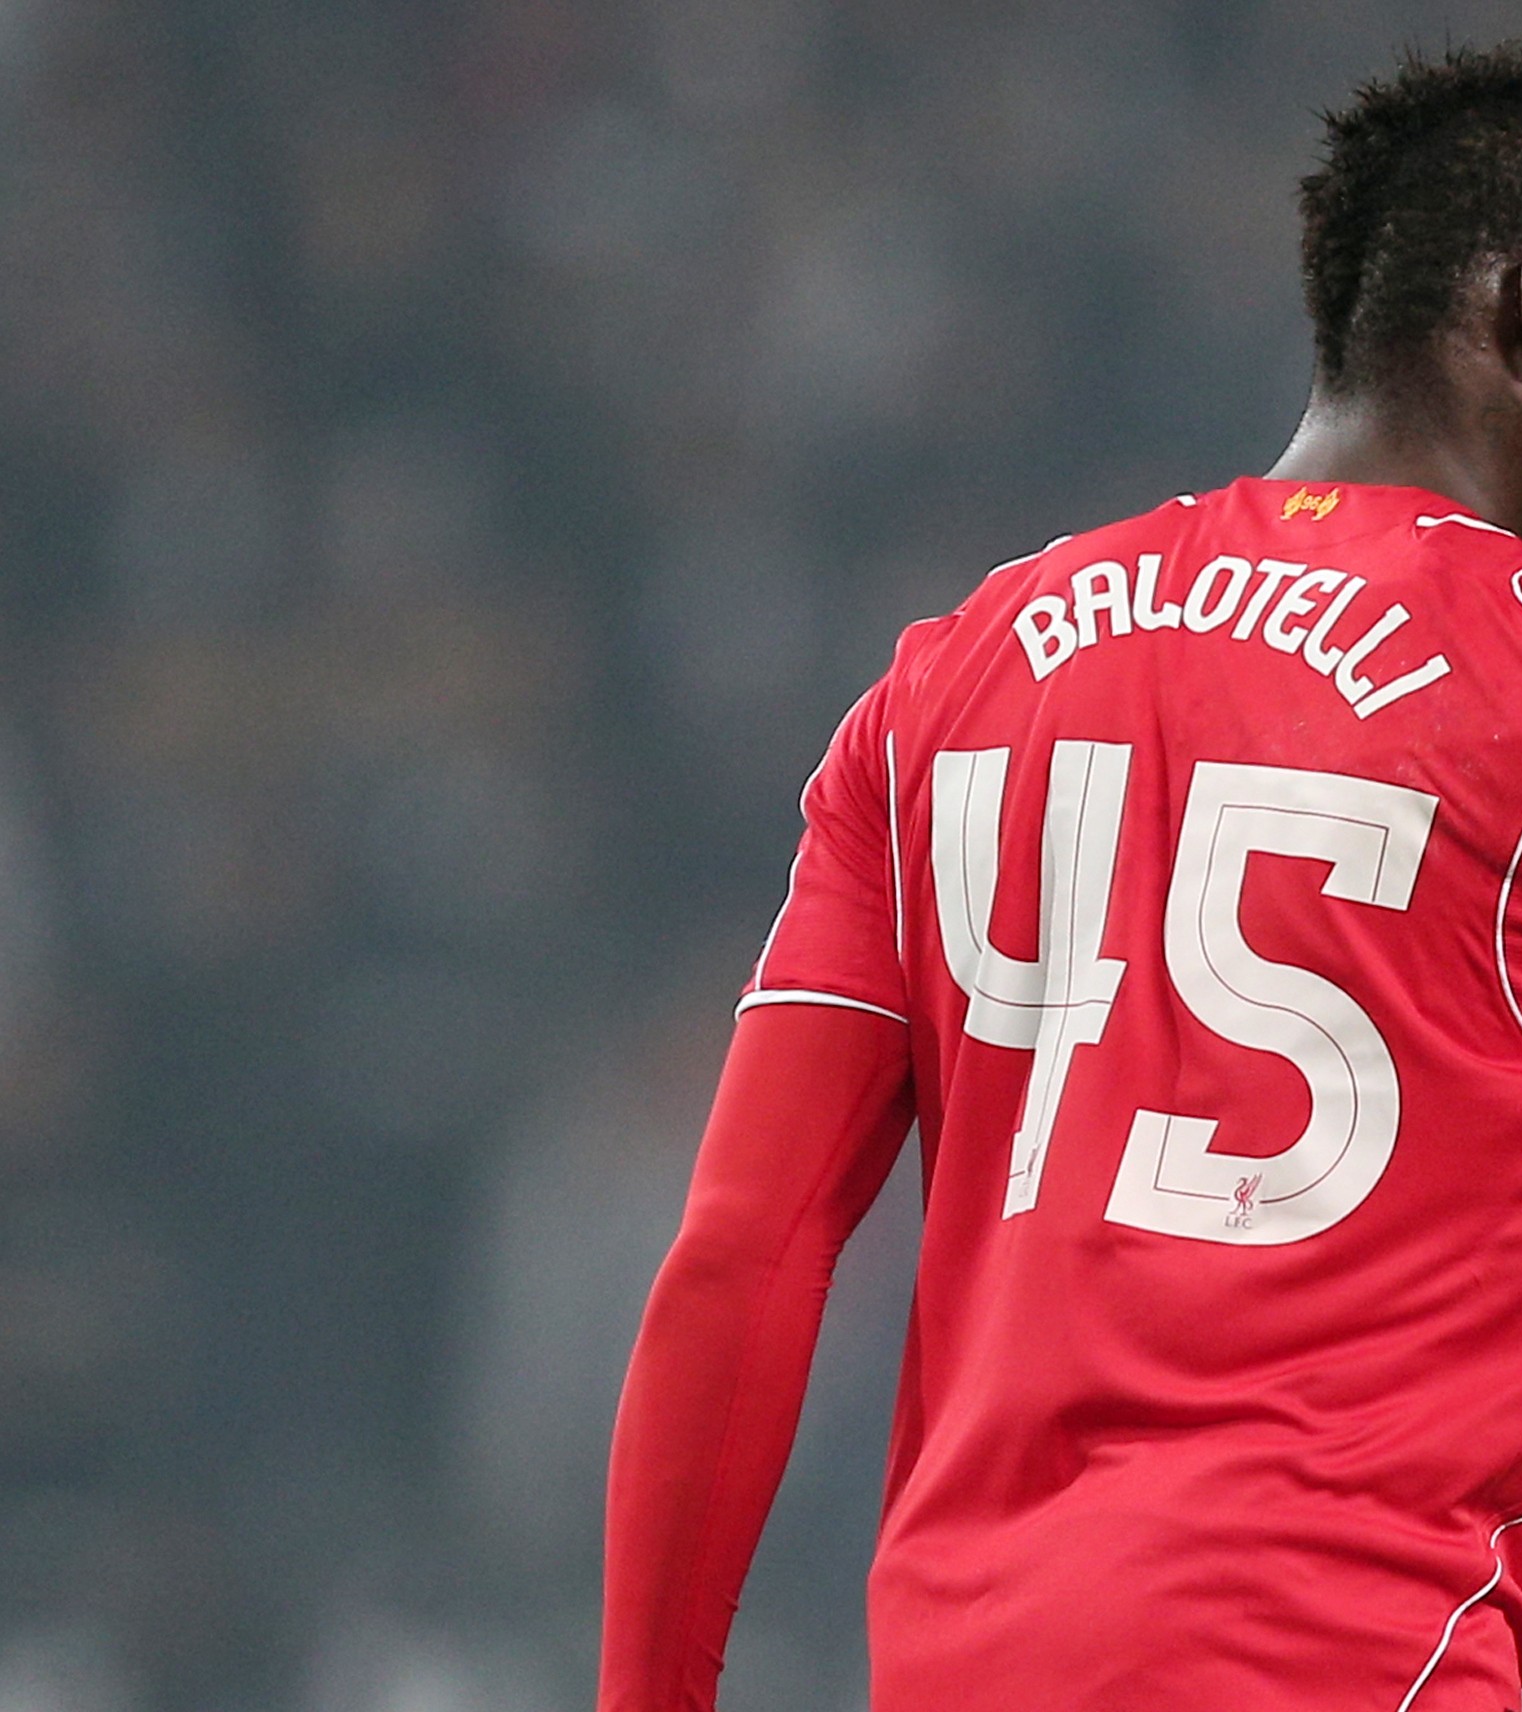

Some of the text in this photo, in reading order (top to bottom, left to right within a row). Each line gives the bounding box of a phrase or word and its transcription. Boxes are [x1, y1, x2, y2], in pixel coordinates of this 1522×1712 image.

[1012, 554, 1452, 721] BALOTELLI
[931, 739, 1440, 1247] 45
[1224, 1216, 1253, 1230] LFC
